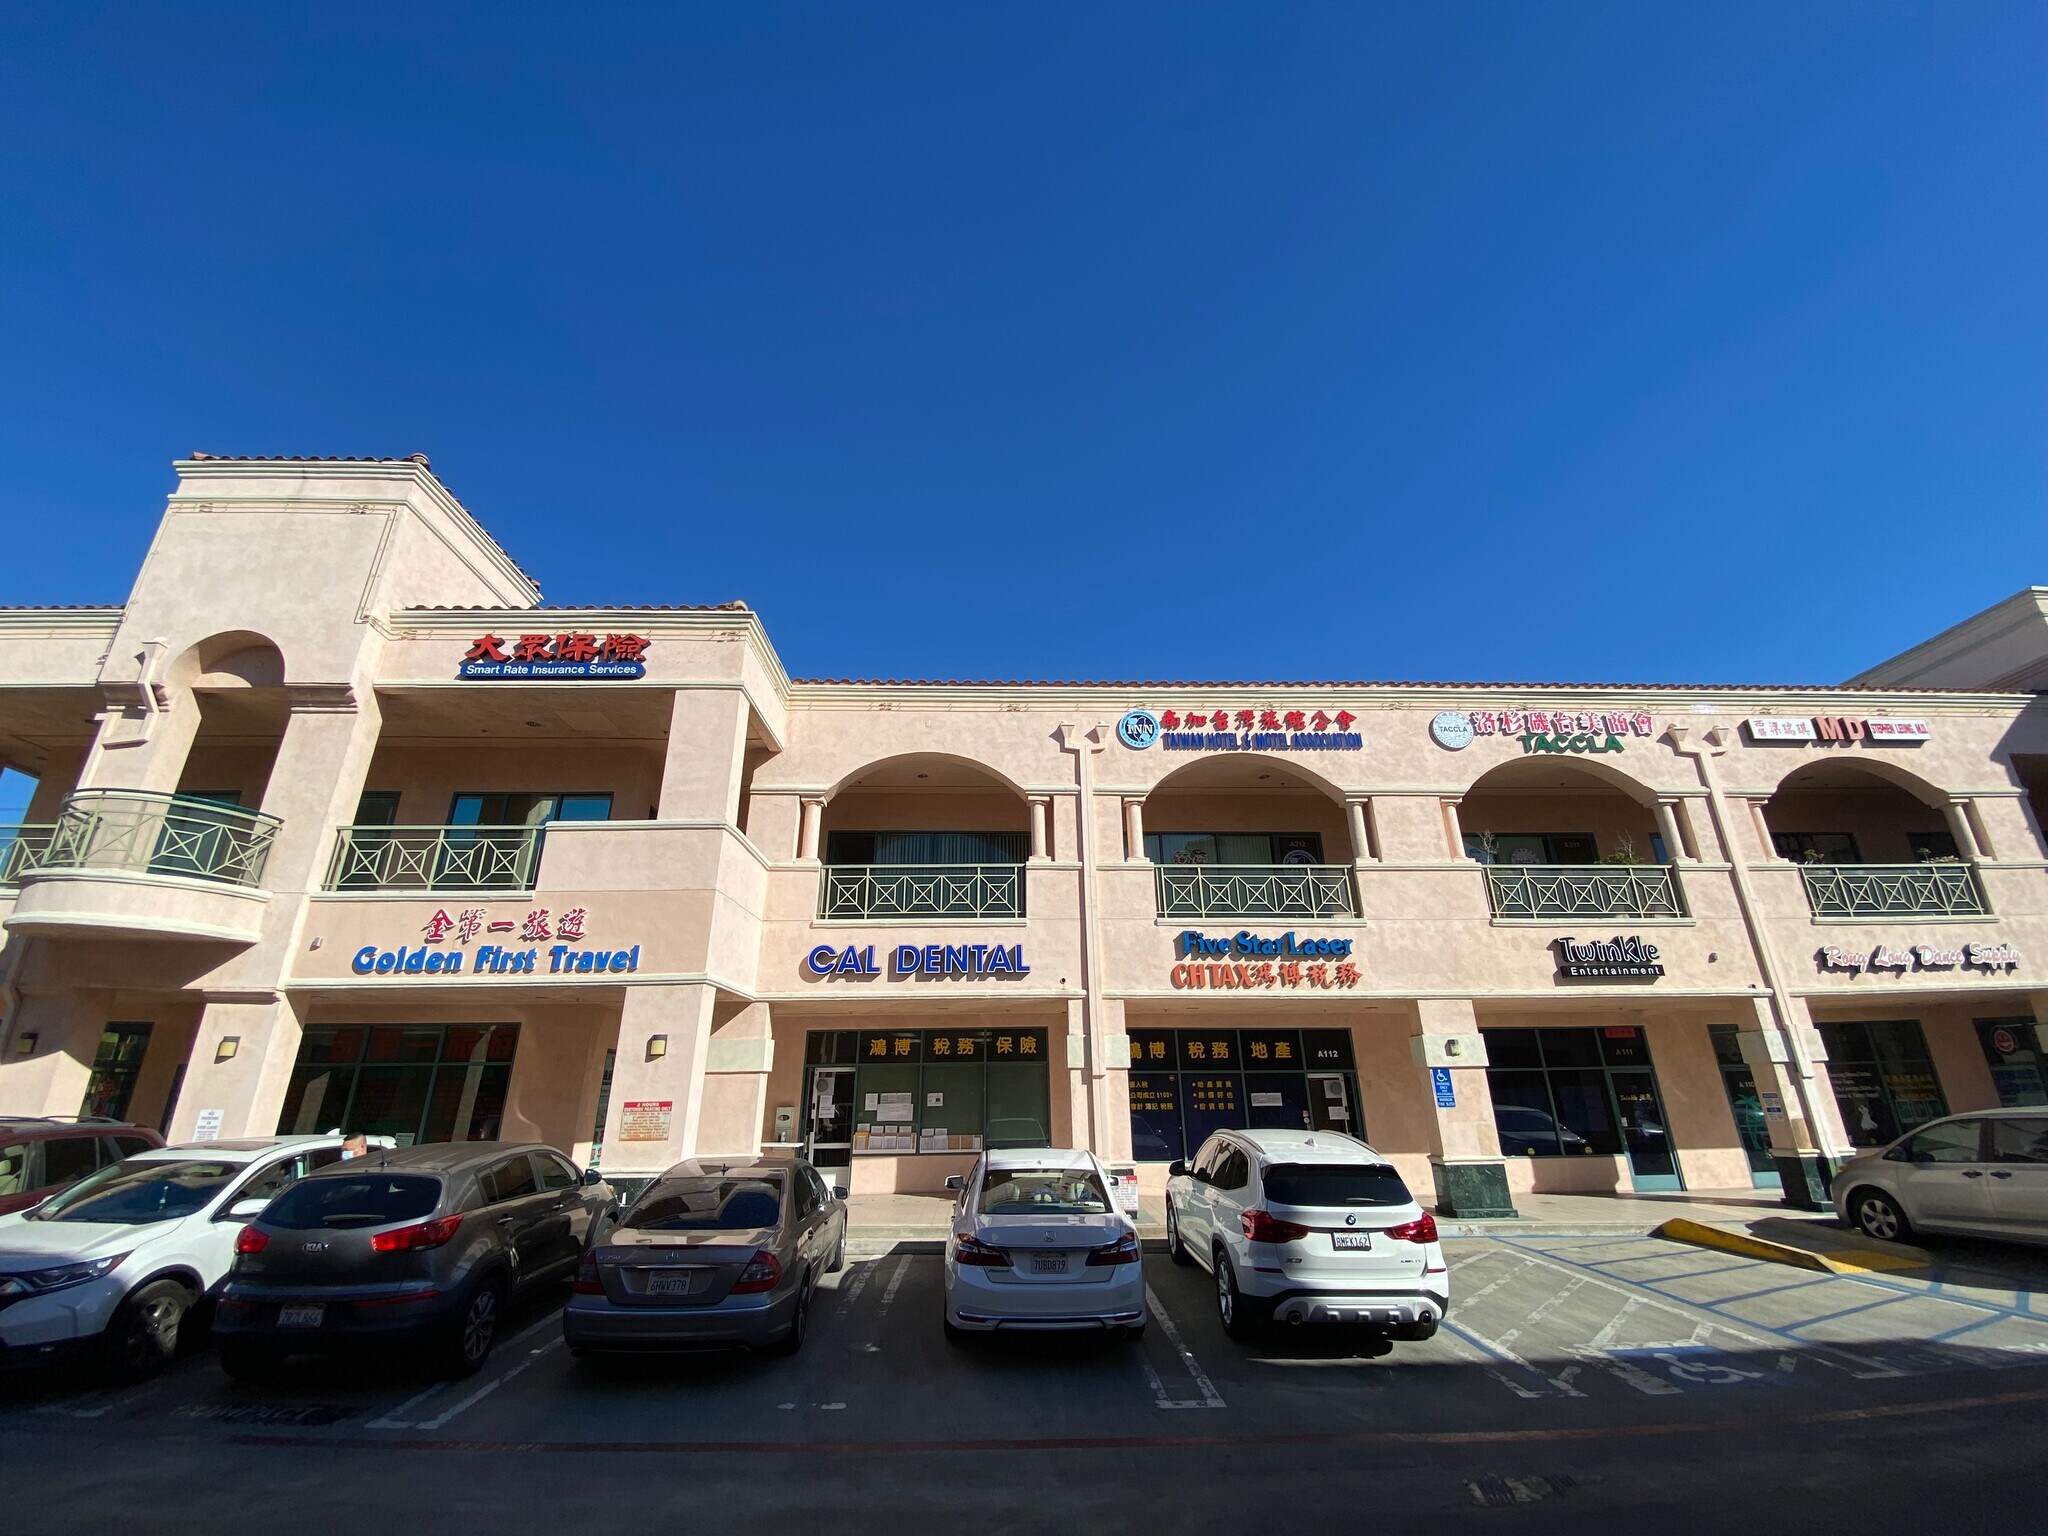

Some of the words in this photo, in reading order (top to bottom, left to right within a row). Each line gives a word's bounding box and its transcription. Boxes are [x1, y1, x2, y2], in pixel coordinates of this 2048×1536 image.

[466, 665, 500, 674] Smart
[503, 665, 529, 674] Rate
[531, 665, 585, 674] Insurance
[588, 665, 637, 674] Services
[1126, 724, 1153, 734] INN
[1869, 723, 1894, 734] STEPHEN
[1164, 733, 1204, 749] TAIWAN
[1206, 733, 1239, 749] HOTEL
[1241, 731, 1252, 750] &
[1253, 733, 1288, 749] MOTEL
[1291, 733, 1363, 749] ASSOCIATION
[1518, 734, 1625, 752] TACCLA
[1289, 840, 1307, 848] A212
[1182, 931, 1231, 955] Five
[1236, 931, 1285, 955] Star
[1286, 932, 1353, 955] Laser
[1557, 936, 1660, 963] Twinkle
[352, 946, 464, 974] Golden
[474, 945, 538, 973] First
[552, 945, 641, 973] Travel
[808, 945, 882, 974] CAL
[896, 944, 1031, 974] DENTAL
[1823, 945, 1867, 972] Rong
[1875, 944, 1914, 971] Long
[1917, 945, 1964, 965] Dance
[1969, 942, 2021, 969] Supply
[1570, 966, 1660, 976] Entertainment
[933, 1037, 974, 1055] 稅務
[996, 1035, 1037, 1054] 保險
[1188, 1042, 1229, 1059] 稅務
[1250, 1042, 1292, 1059] 地產
[1317, 1050, 1339, 1058] A112
[305, 1242, 323, 1252] KIA
[1033, 1259, 1066, 1271] 7UBD879
[650, 1280, 687, 1291] 6HWV378
